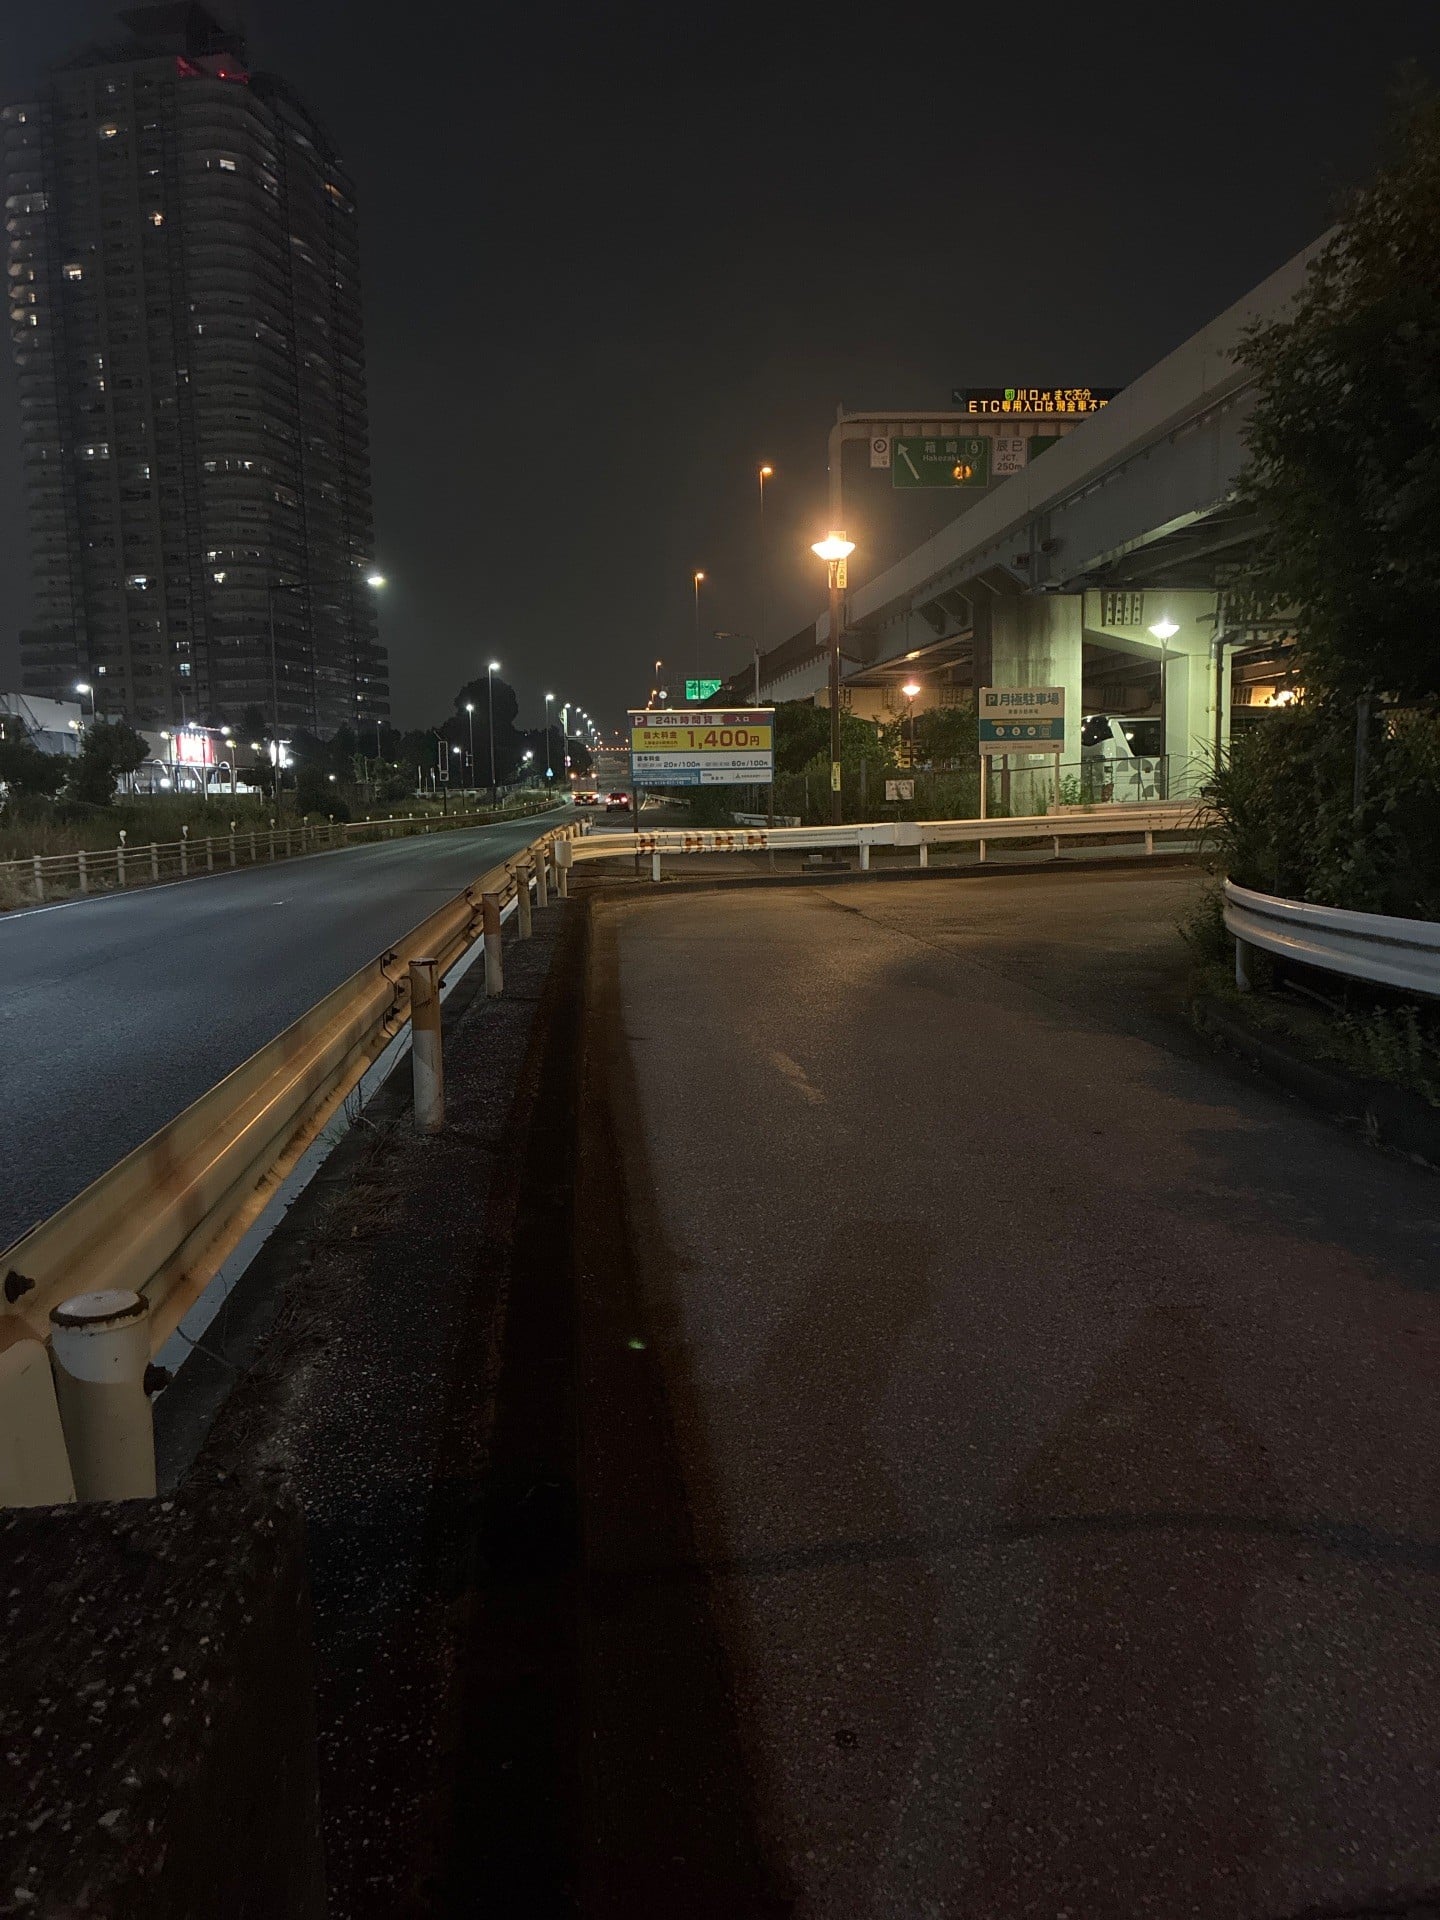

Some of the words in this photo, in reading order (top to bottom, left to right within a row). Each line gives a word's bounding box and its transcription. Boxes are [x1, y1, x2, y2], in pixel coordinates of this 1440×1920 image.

[997, 463, 1022, 471] 250m
[999, 693, 1059, 705] 月極駐車場
[634, 715, 644, 726] P
